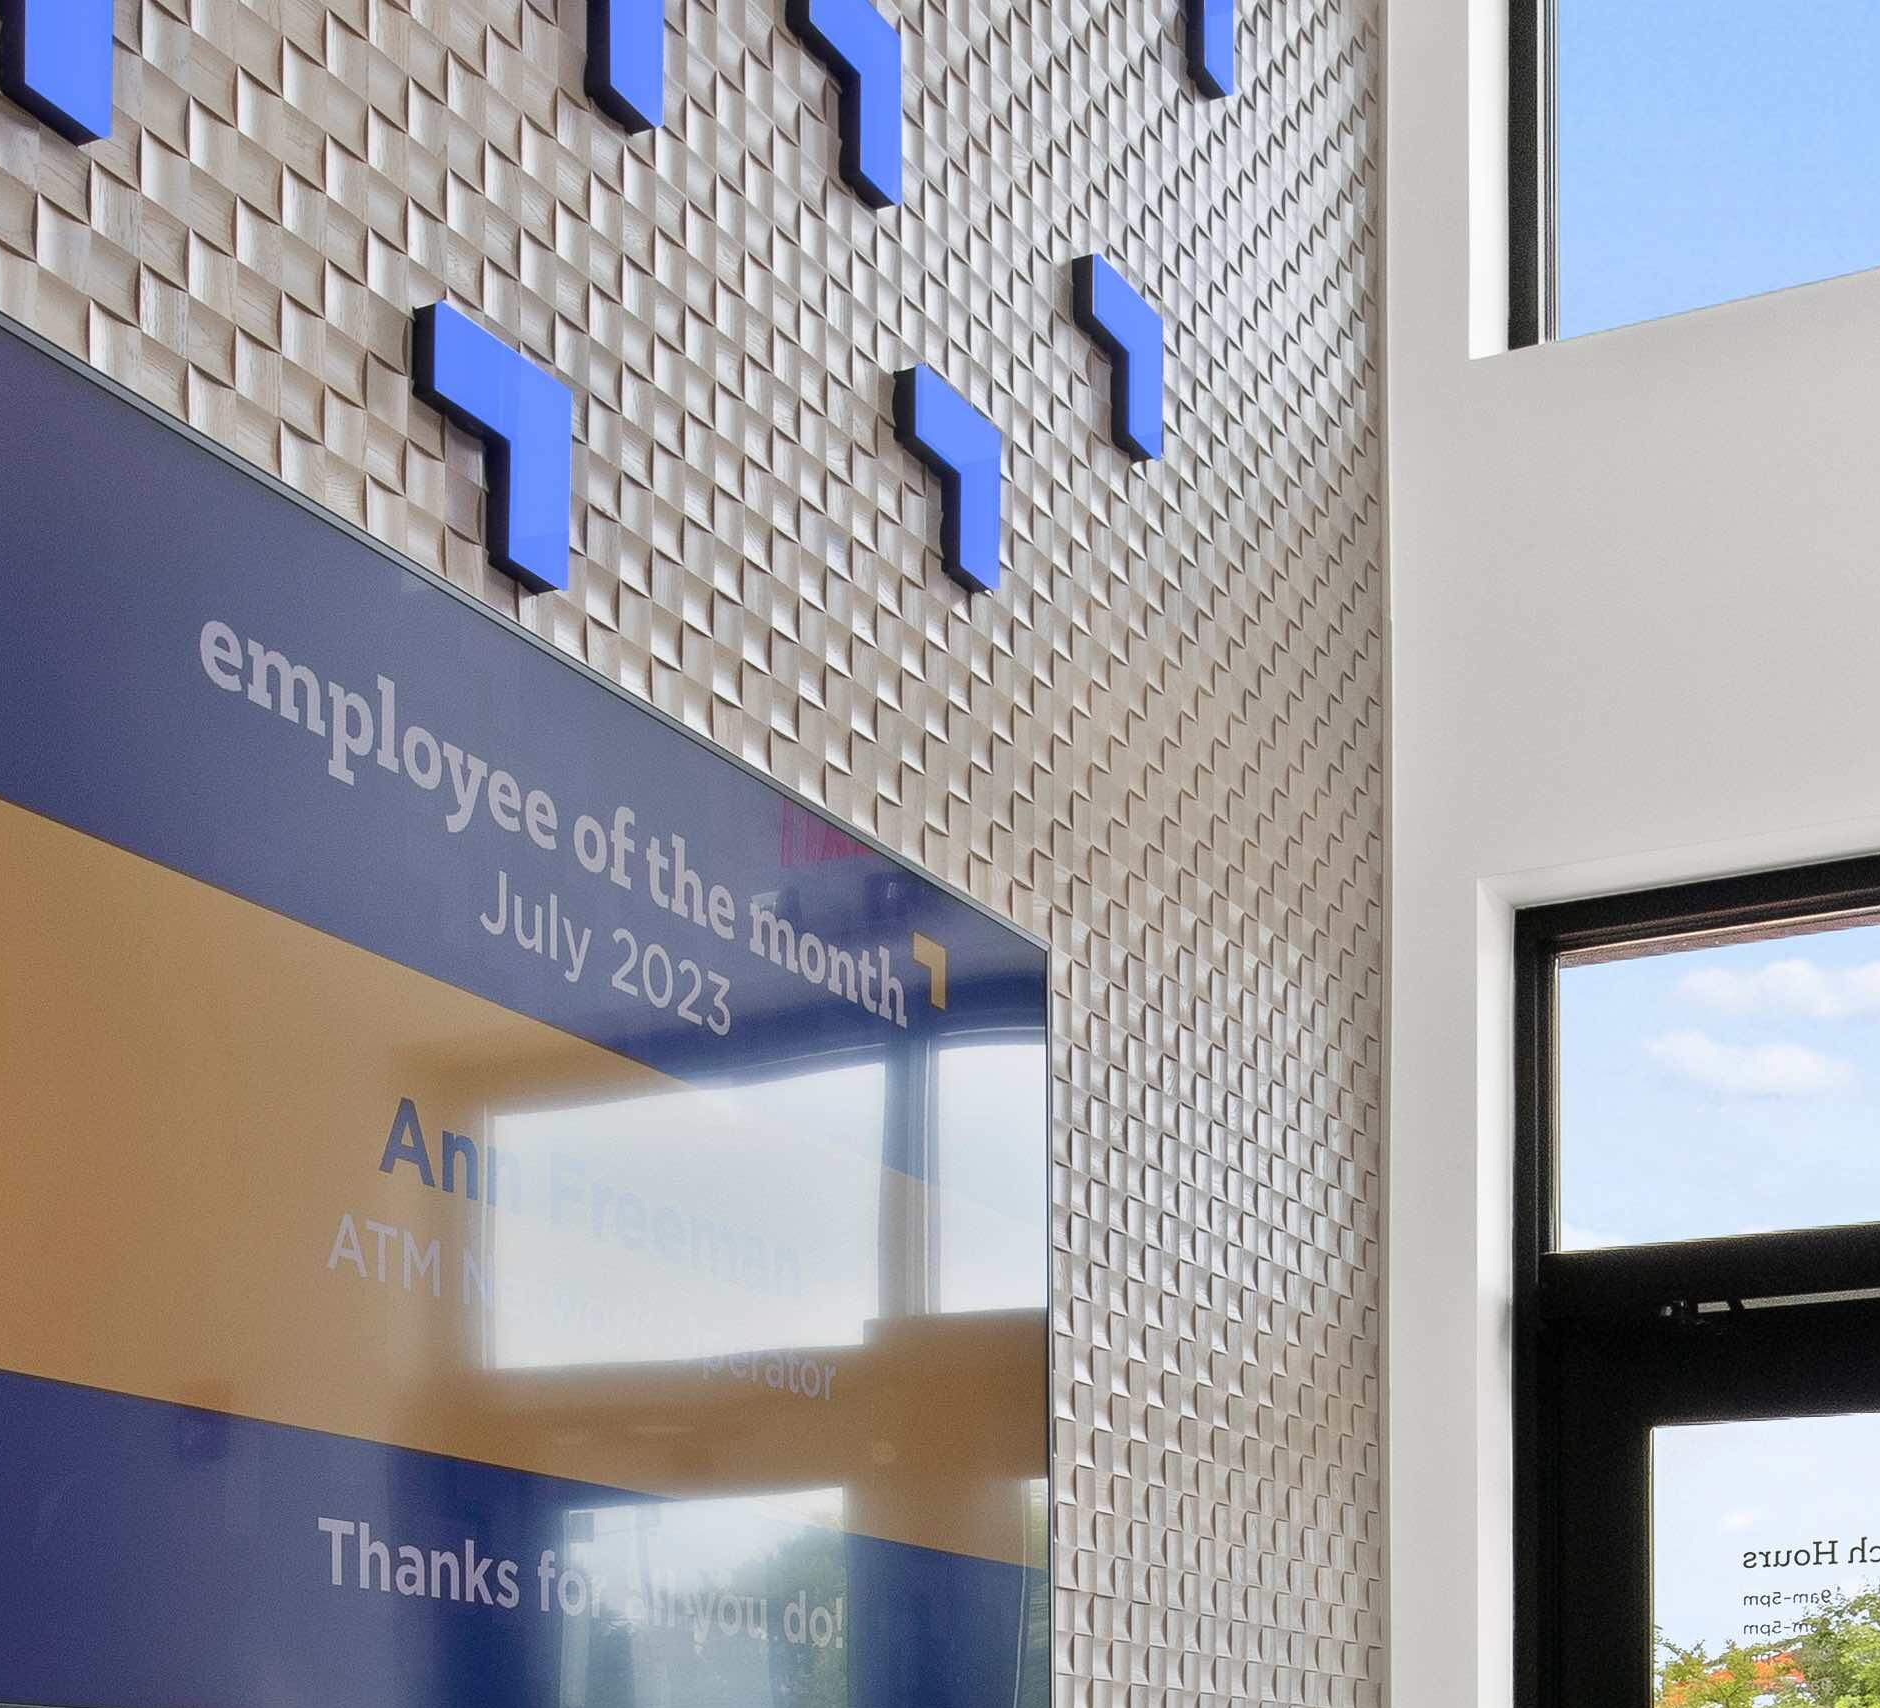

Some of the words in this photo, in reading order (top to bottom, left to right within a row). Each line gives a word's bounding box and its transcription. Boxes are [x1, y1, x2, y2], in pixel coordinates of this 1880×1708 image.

[199, 620, 559, 851] employee
[573, 806, 636, 889] of
[646, 832, 736, 941] the
[748, 898, 907, 1028] month
[479, 870, 592, 983] July
[611, 927, 731, 1036] 2023
[377, 1096, 521, 1215] Ann
[326, 1213, 442, 1298] ATM
[317, 1517, 521, 1609] Thanks
[537, 1548, 608, 1619] for
[691, 1596, 768, 1648] you
[783, 1590, 844, 1650] do!
